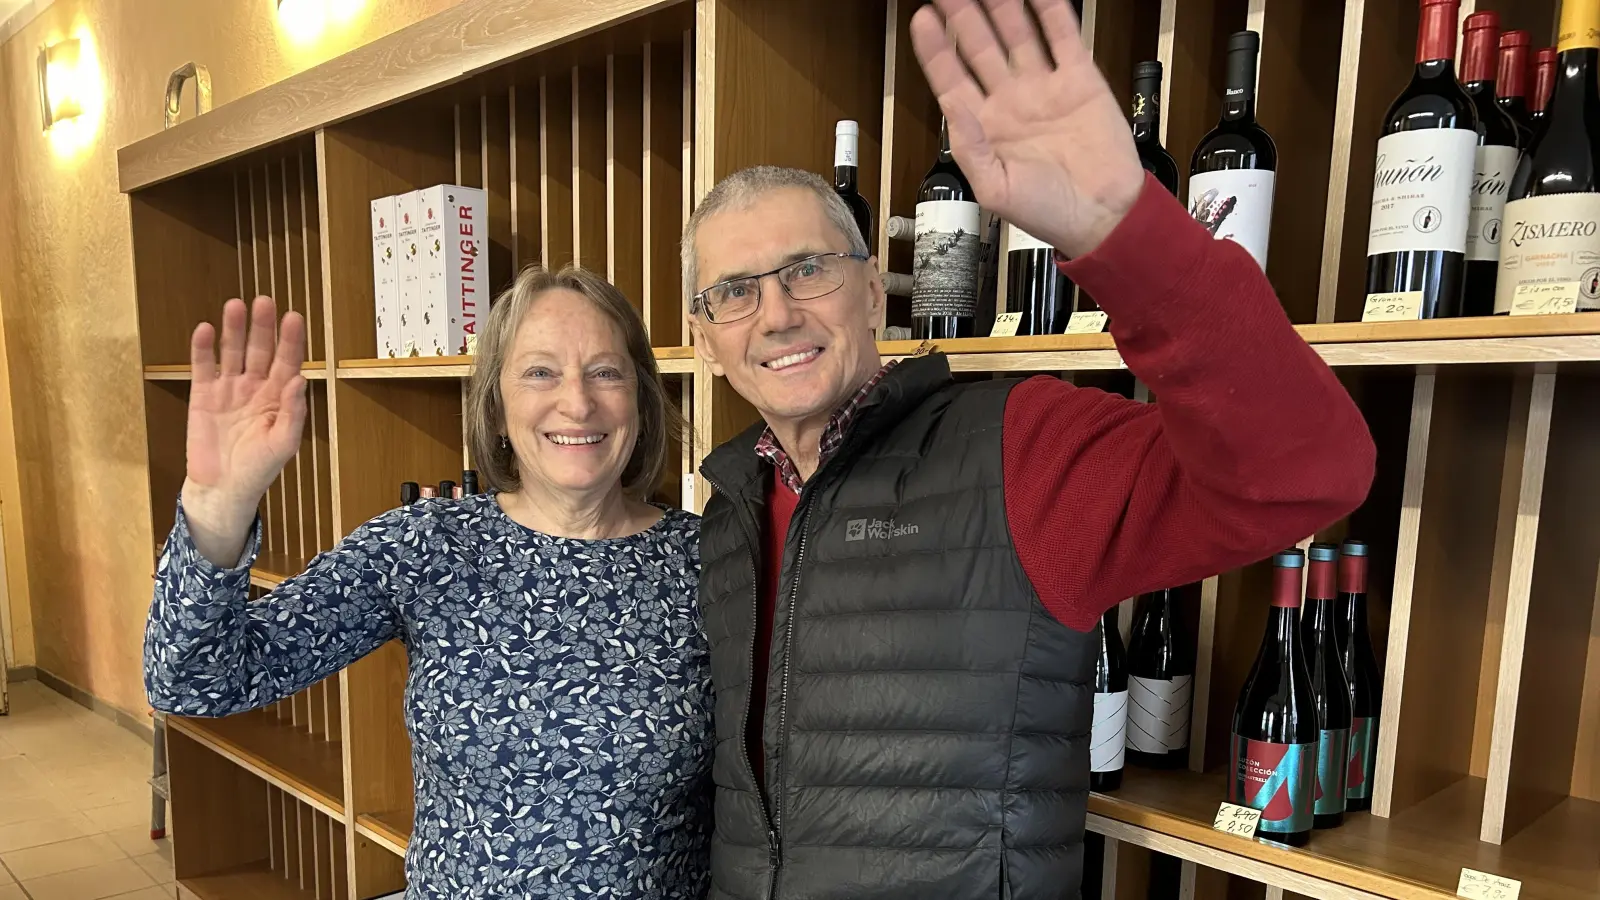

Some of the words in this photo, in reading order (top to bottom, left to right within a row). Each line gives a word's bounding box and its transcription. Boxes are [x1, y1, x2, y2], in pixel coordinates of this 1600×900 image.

[1380, 203, 1394, 211] 2017
[1509, 220, 1597, 247] ZISMERO
[1524, 252, 1569, 262] GARNACHA
[867, 518, 896, 529] Jack
[1238, 757, 1260, 767] LUZÓN
[1238, 763, 1278, 777] COLECCIÓN
